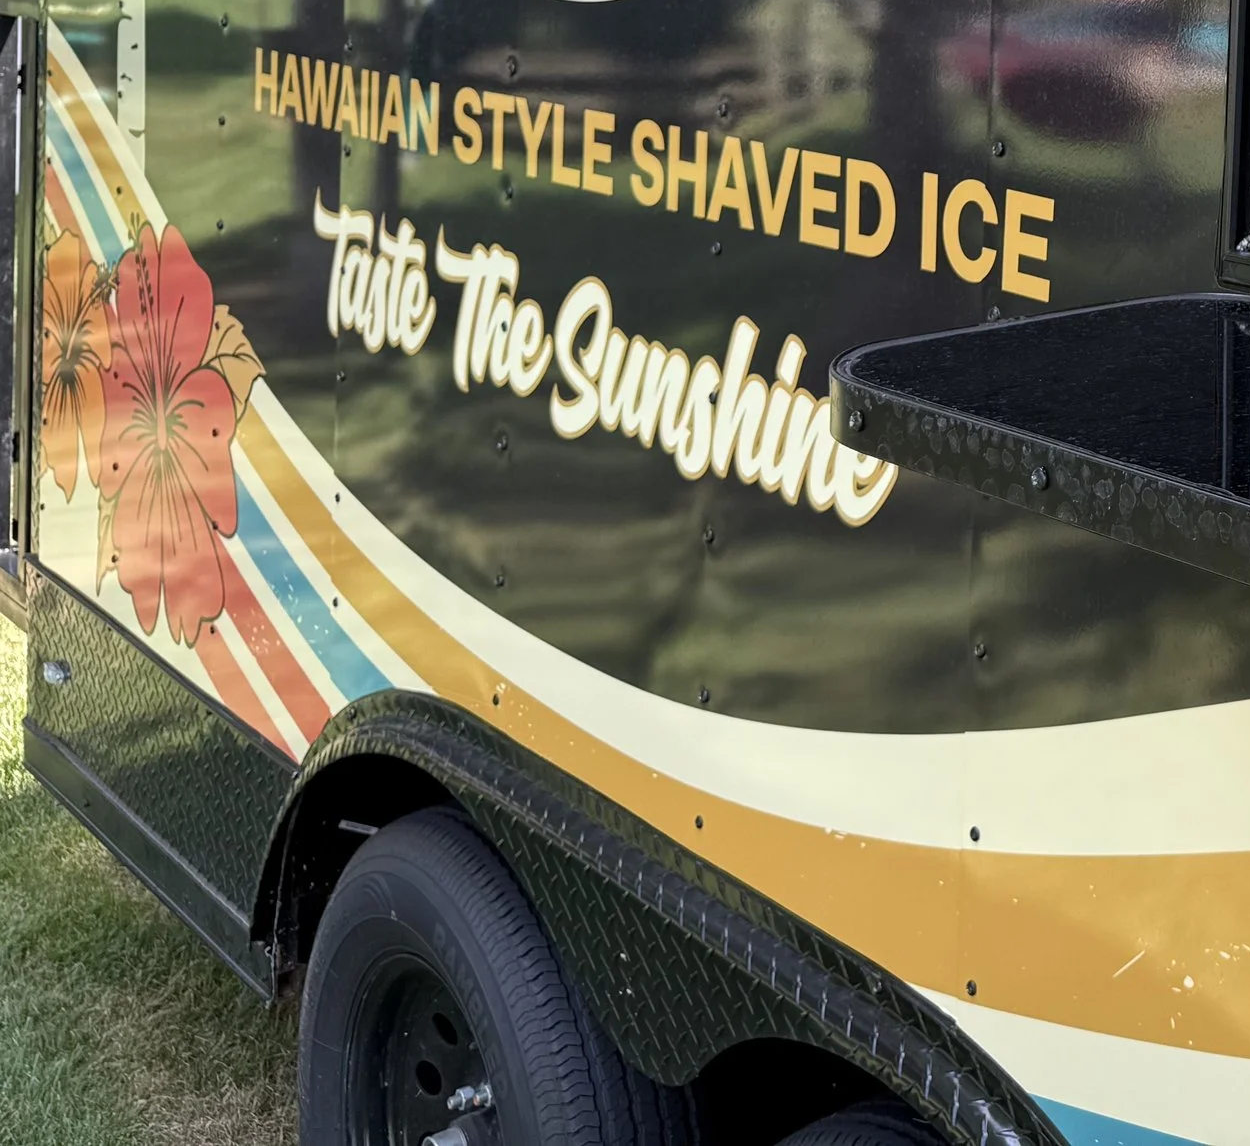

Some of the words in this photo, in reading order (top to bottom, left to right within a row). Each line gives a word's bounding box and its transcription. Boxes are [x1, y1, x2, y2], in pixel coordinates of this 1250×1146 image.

[254, 47, 440, 156] HAWAIIAN
[452, 86, 615, 196] STYLE
[630, 118, 897, 258] SHAVED
[920, 172, 1055, 303] ICE
[313, 188, 436, 356] Taste
[435, 223, 554, 399] The
